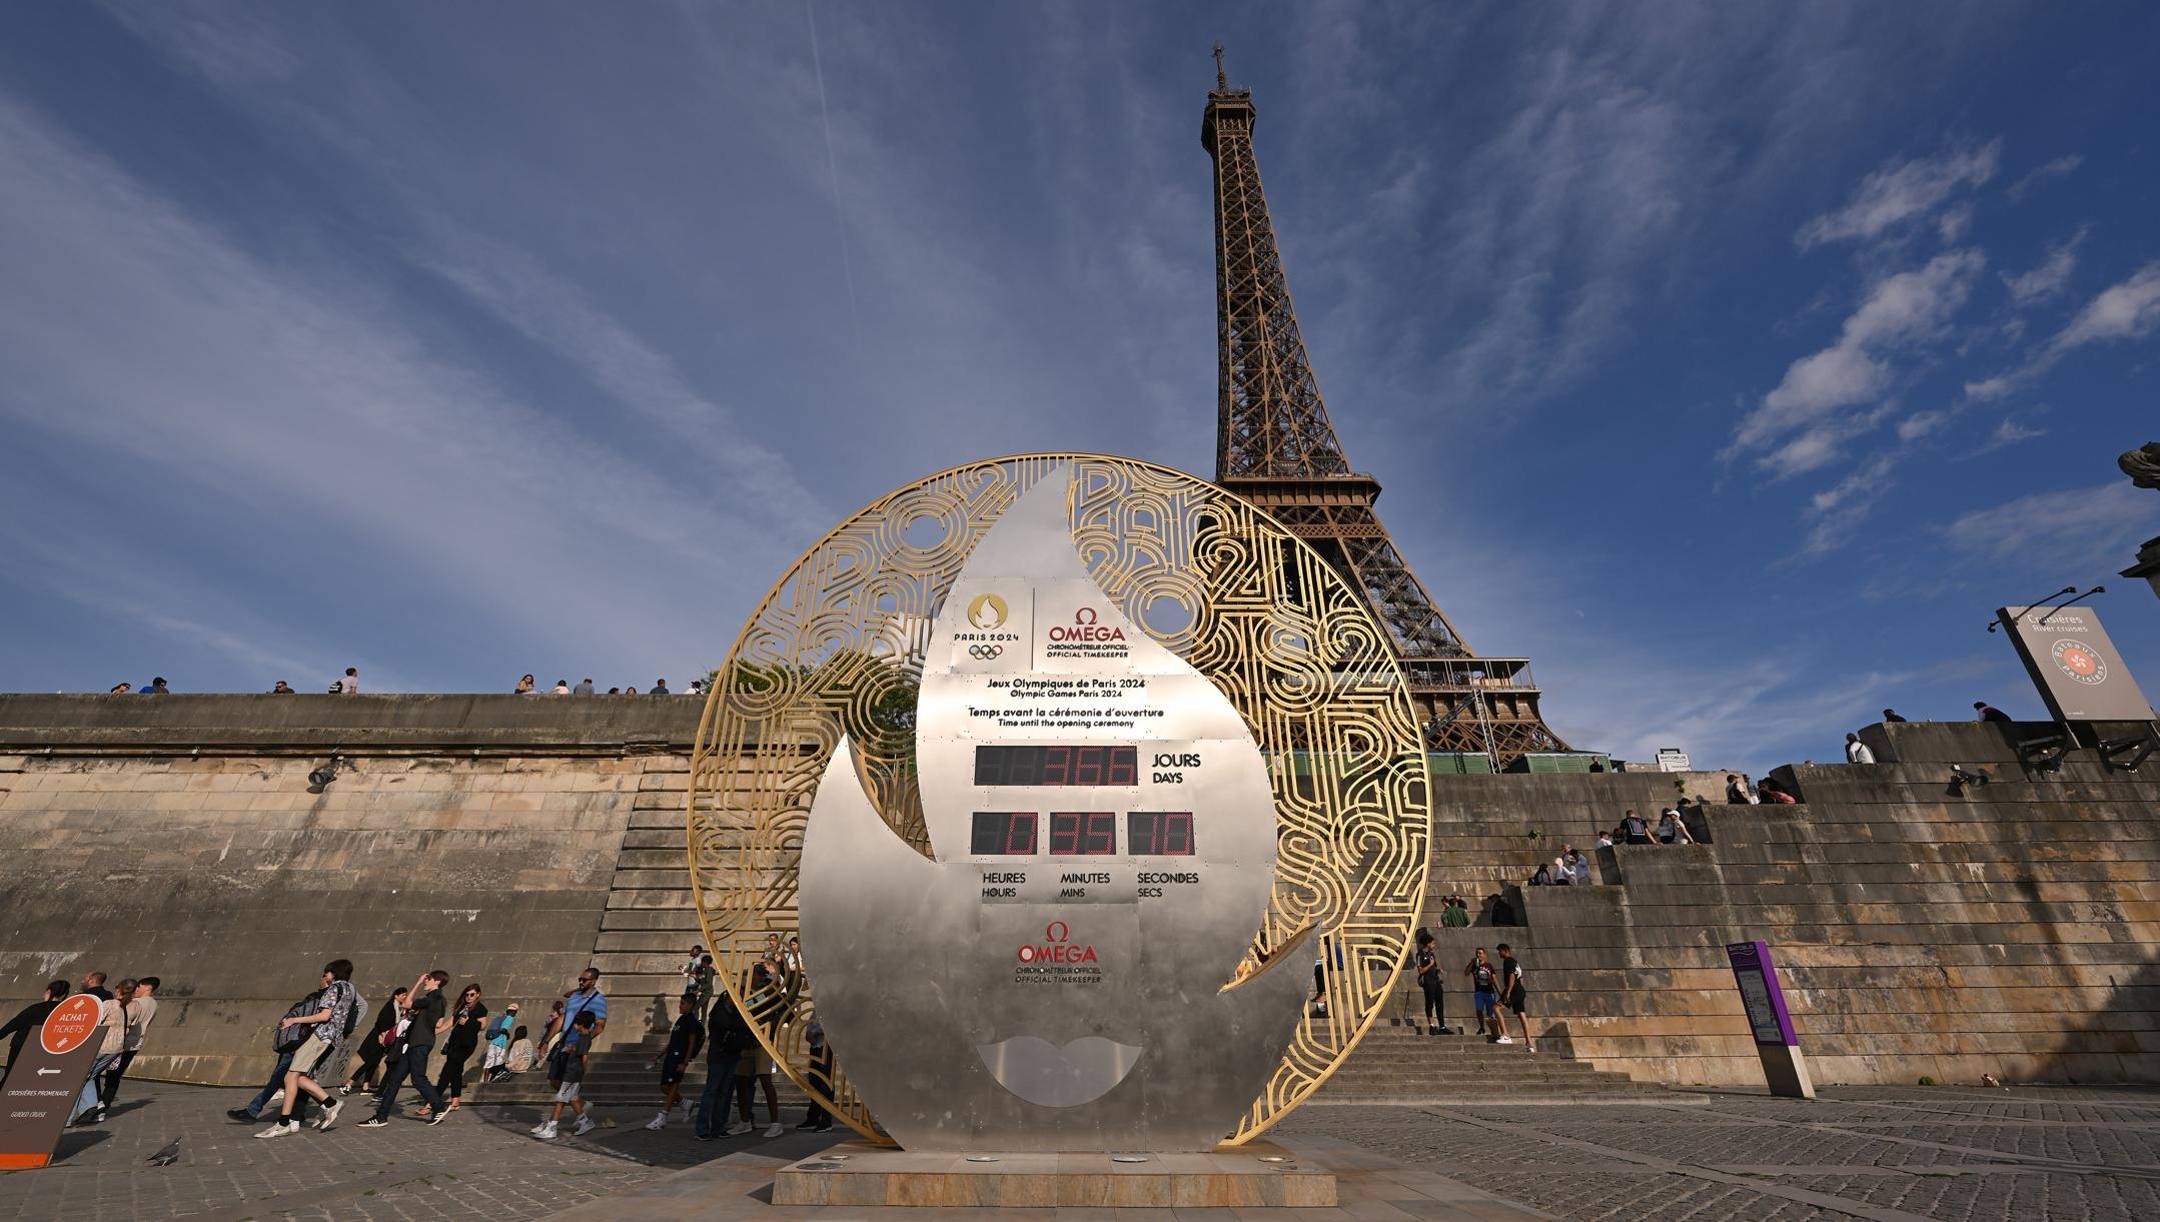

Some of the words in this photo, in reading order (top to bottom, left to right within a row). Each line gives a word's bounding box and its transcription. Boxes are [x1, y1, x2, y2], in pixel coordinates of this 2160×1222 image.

[954, 633, 987, 642] PARIS
[990, 633, 1020, 642] 2024
[1049, 626, 1126, 642] OMEGA
[1047, 643, 1101, 651] CHRONOMÉTREUR
[987, 678, 1011, 688] Jeux
[1013, 678, 1074, 690] Olympiques
[1076, 679, 1090, 688] de
[1092, 679, 1117, 688] Paris
[1119, 679, 1146, 688] 2024
[1010, 689, 1046, 699] Olympic
[1047, 689, 1077, 697] Games
[968, 707, 1001, 719] Temps
[1003, 708, 1034, 717] avant
[1036, 707, 1046, 717] la
[1048, 707, 1102, 717] cérémonie
[998, 718, 1019, 727] Time
[1020, 718, 1039, 727] until
[1041, 718, 1055, 727] the
[1057, 719, 1092, 729] opening
[1093, 720, 1135, 729] ceremony
[1042, 746, 1136, 786] 366
[1151, 753, 1201, 768] JOURS
[1152, 772, 1184, 784] DAYS
[1051, 812, 1115, 855] 35
[1151, 812, 1193, 855] 10
[982, 872, 1026, 884] HEURES
[1060, 872, 1111, 884] MINUTES
[1137, 872, 1199, 884] SECONDES
[982, 887, 1017, 898] HOURS
[1060, 887, 1086, 898] MINS
[1137, 887, 1163, 898] SECS
[1018, 945, 1098, 964] OMEGA
[1016, 975, 1052, 983] OFFICIAL
[1054, 975, 1102, 983] TIMEKEEPER
[58, 1013, 89, 1022] ACHAT
[52, 1023, 85, 1034] TICKETS
